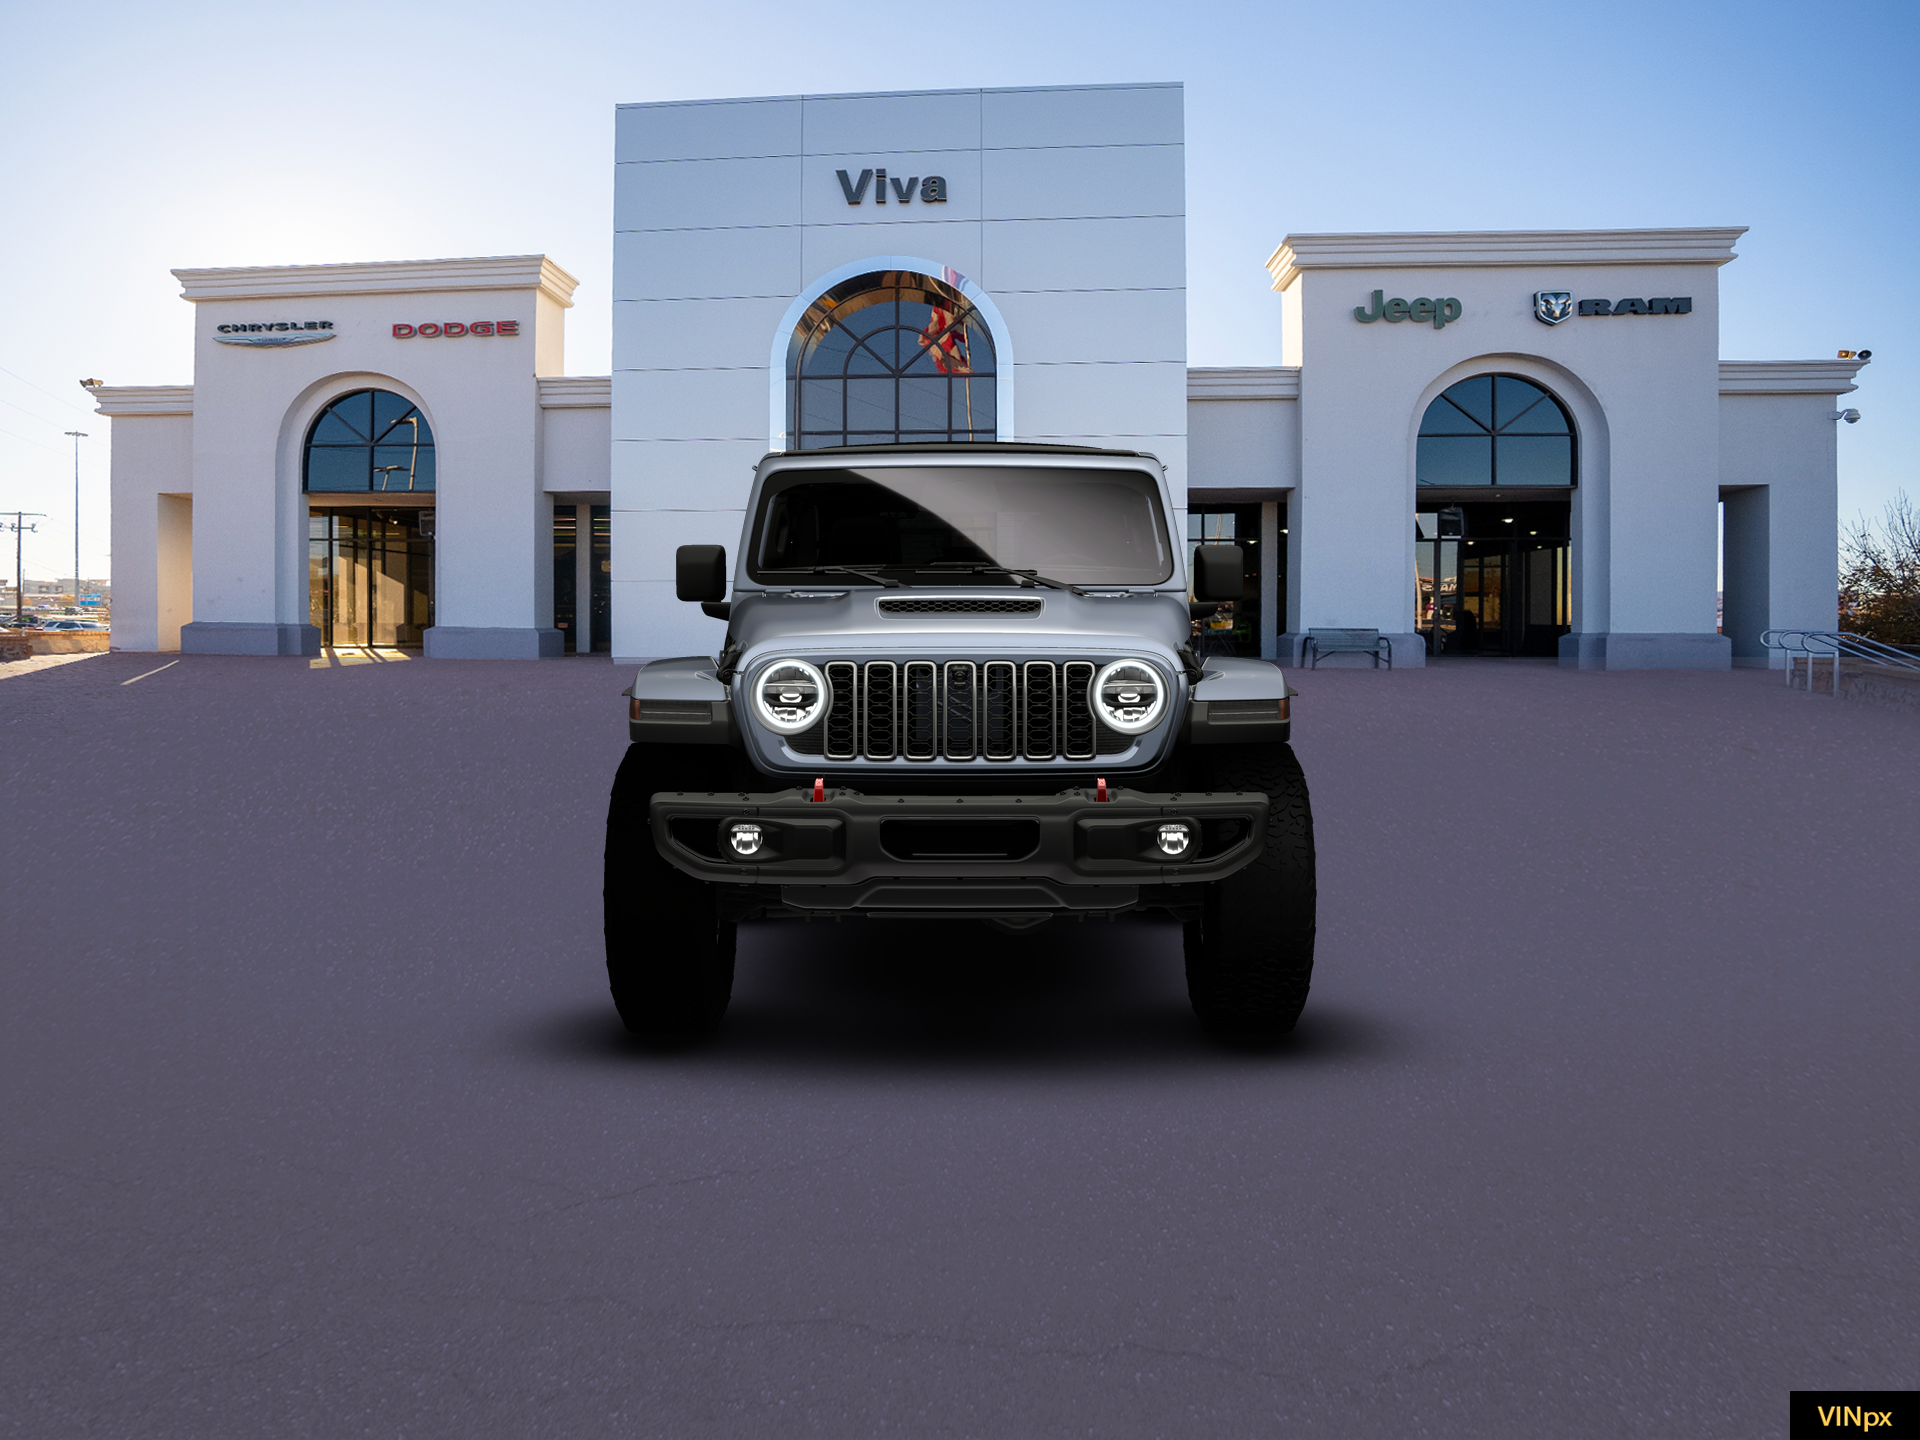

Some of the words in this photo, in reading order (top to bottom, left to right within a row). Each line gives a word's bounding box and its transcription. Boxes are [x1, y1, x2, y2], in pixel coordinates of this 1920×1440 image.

[835, 168, 947, 205] Viva
[1354, 289, 1463, 330] Jeep
[1578, 297, 1693, 316] RAM
[217, 320, 333, 334] CHRYSLER
[392, 319, 520, 339] DODGE
